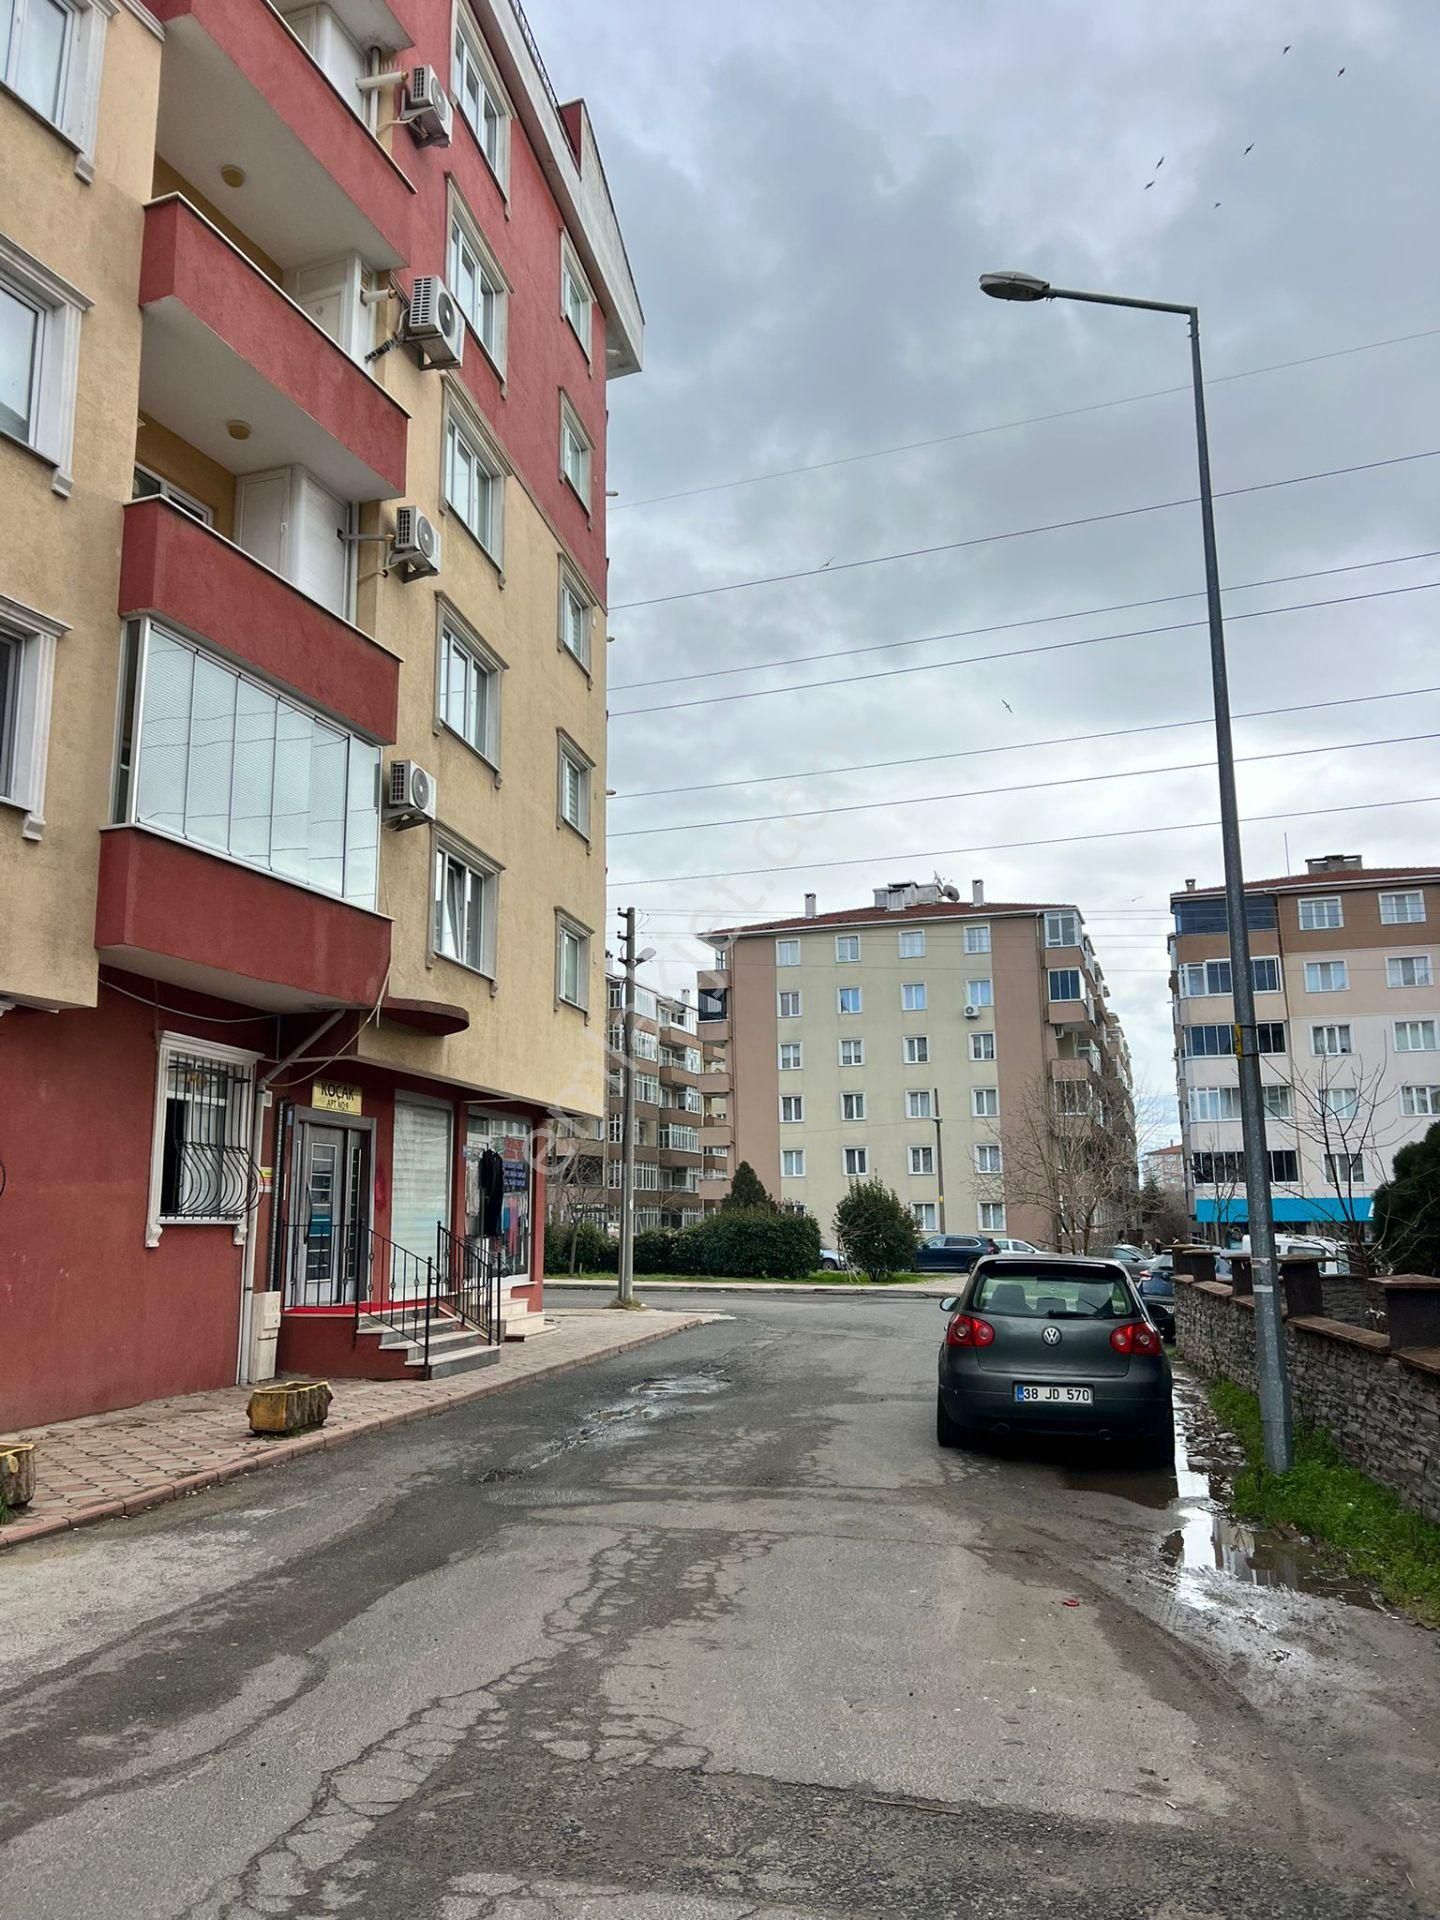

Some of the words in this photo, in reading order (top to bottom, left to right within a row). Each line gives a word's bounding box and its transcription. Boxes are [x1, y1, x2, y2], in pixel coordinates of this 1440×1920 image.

[321, 1082, 355, 1101] KOÇAK
[1024, 1388, 1038, 1399] 38
[1045, 1388, 1059, 1399] JD
[1067, 1389, 1089, 1401] 570
